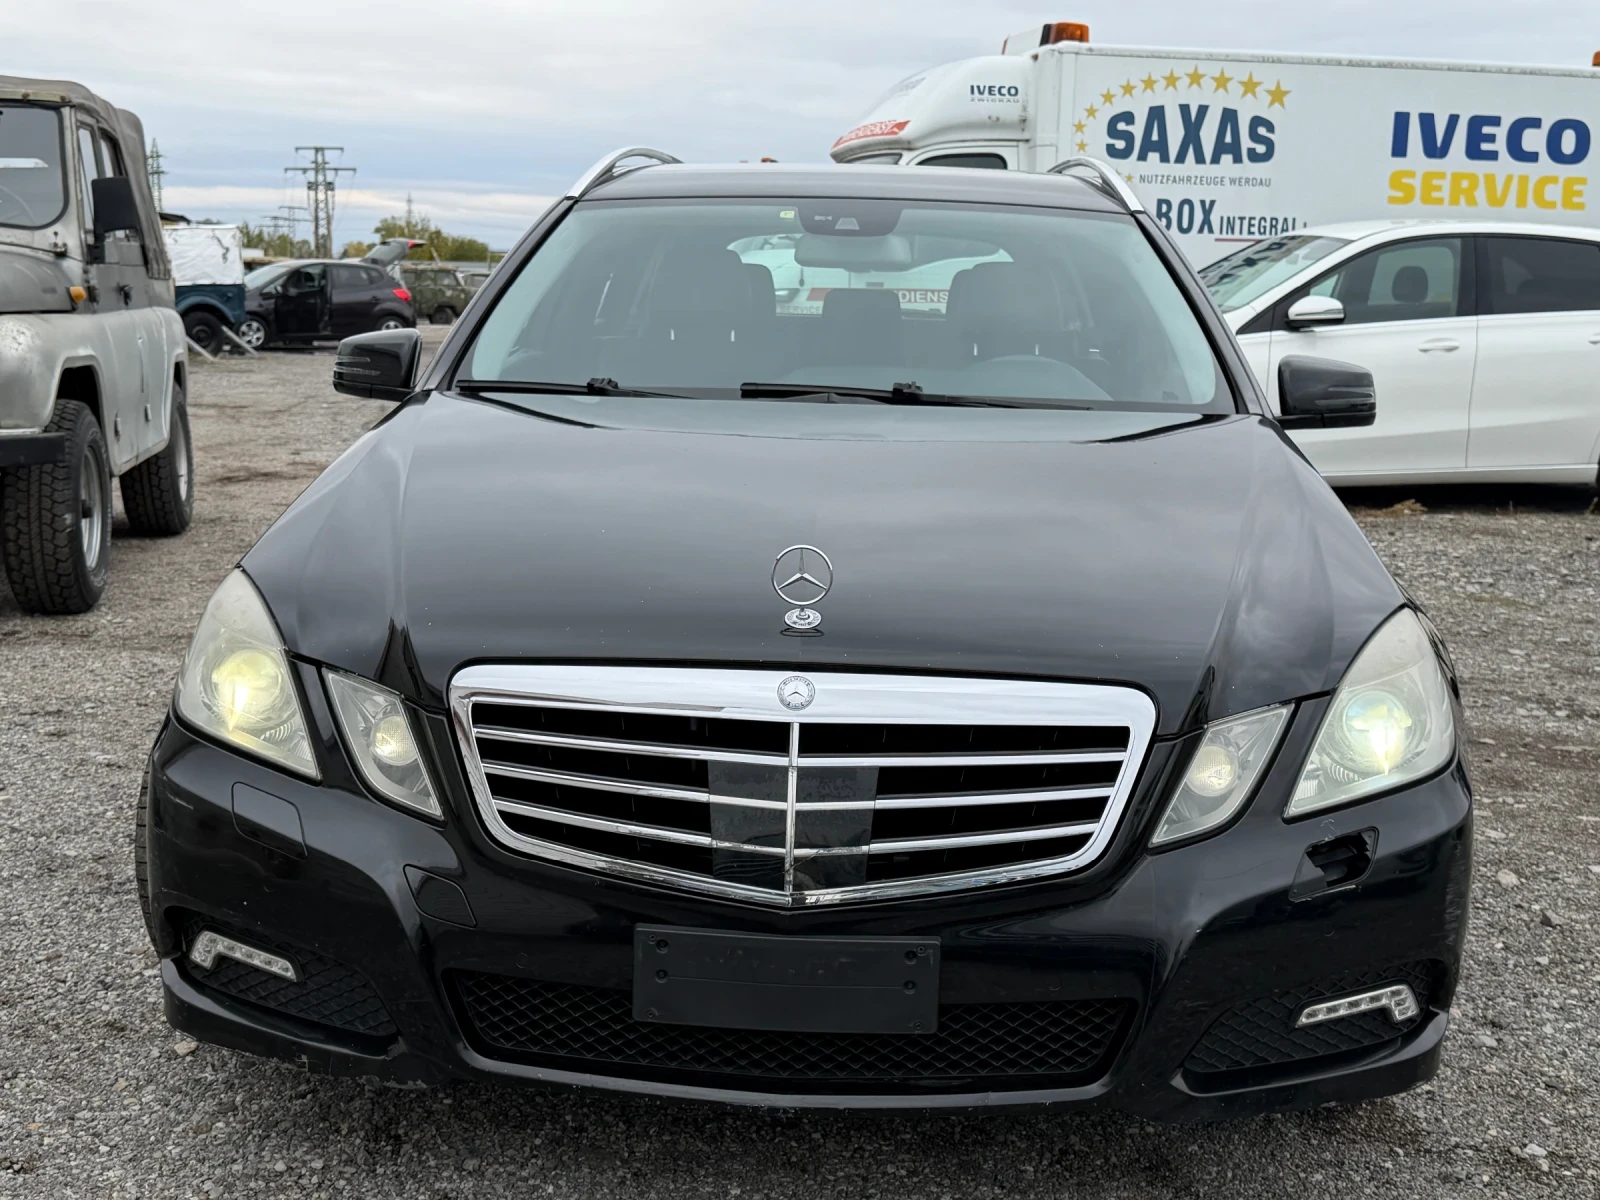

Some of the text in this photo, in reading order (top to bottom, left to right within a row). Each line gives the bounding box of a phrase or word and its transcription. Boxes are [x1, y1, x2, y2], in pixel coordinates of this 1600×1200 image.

[970, 84, 1019, 97] IVECO
[1105, 103, 1276, 165] SAXAS
[1391, 111, 1591, 165] IVECO
[1139, 173, 1272, 188] NUTZFAHRZEUGE WERDAU
[1387, 169, 1588, 211] SERVICE
[1155, 198, 1217, 235] BOX
[894, 290, 949, 303] DIENS
